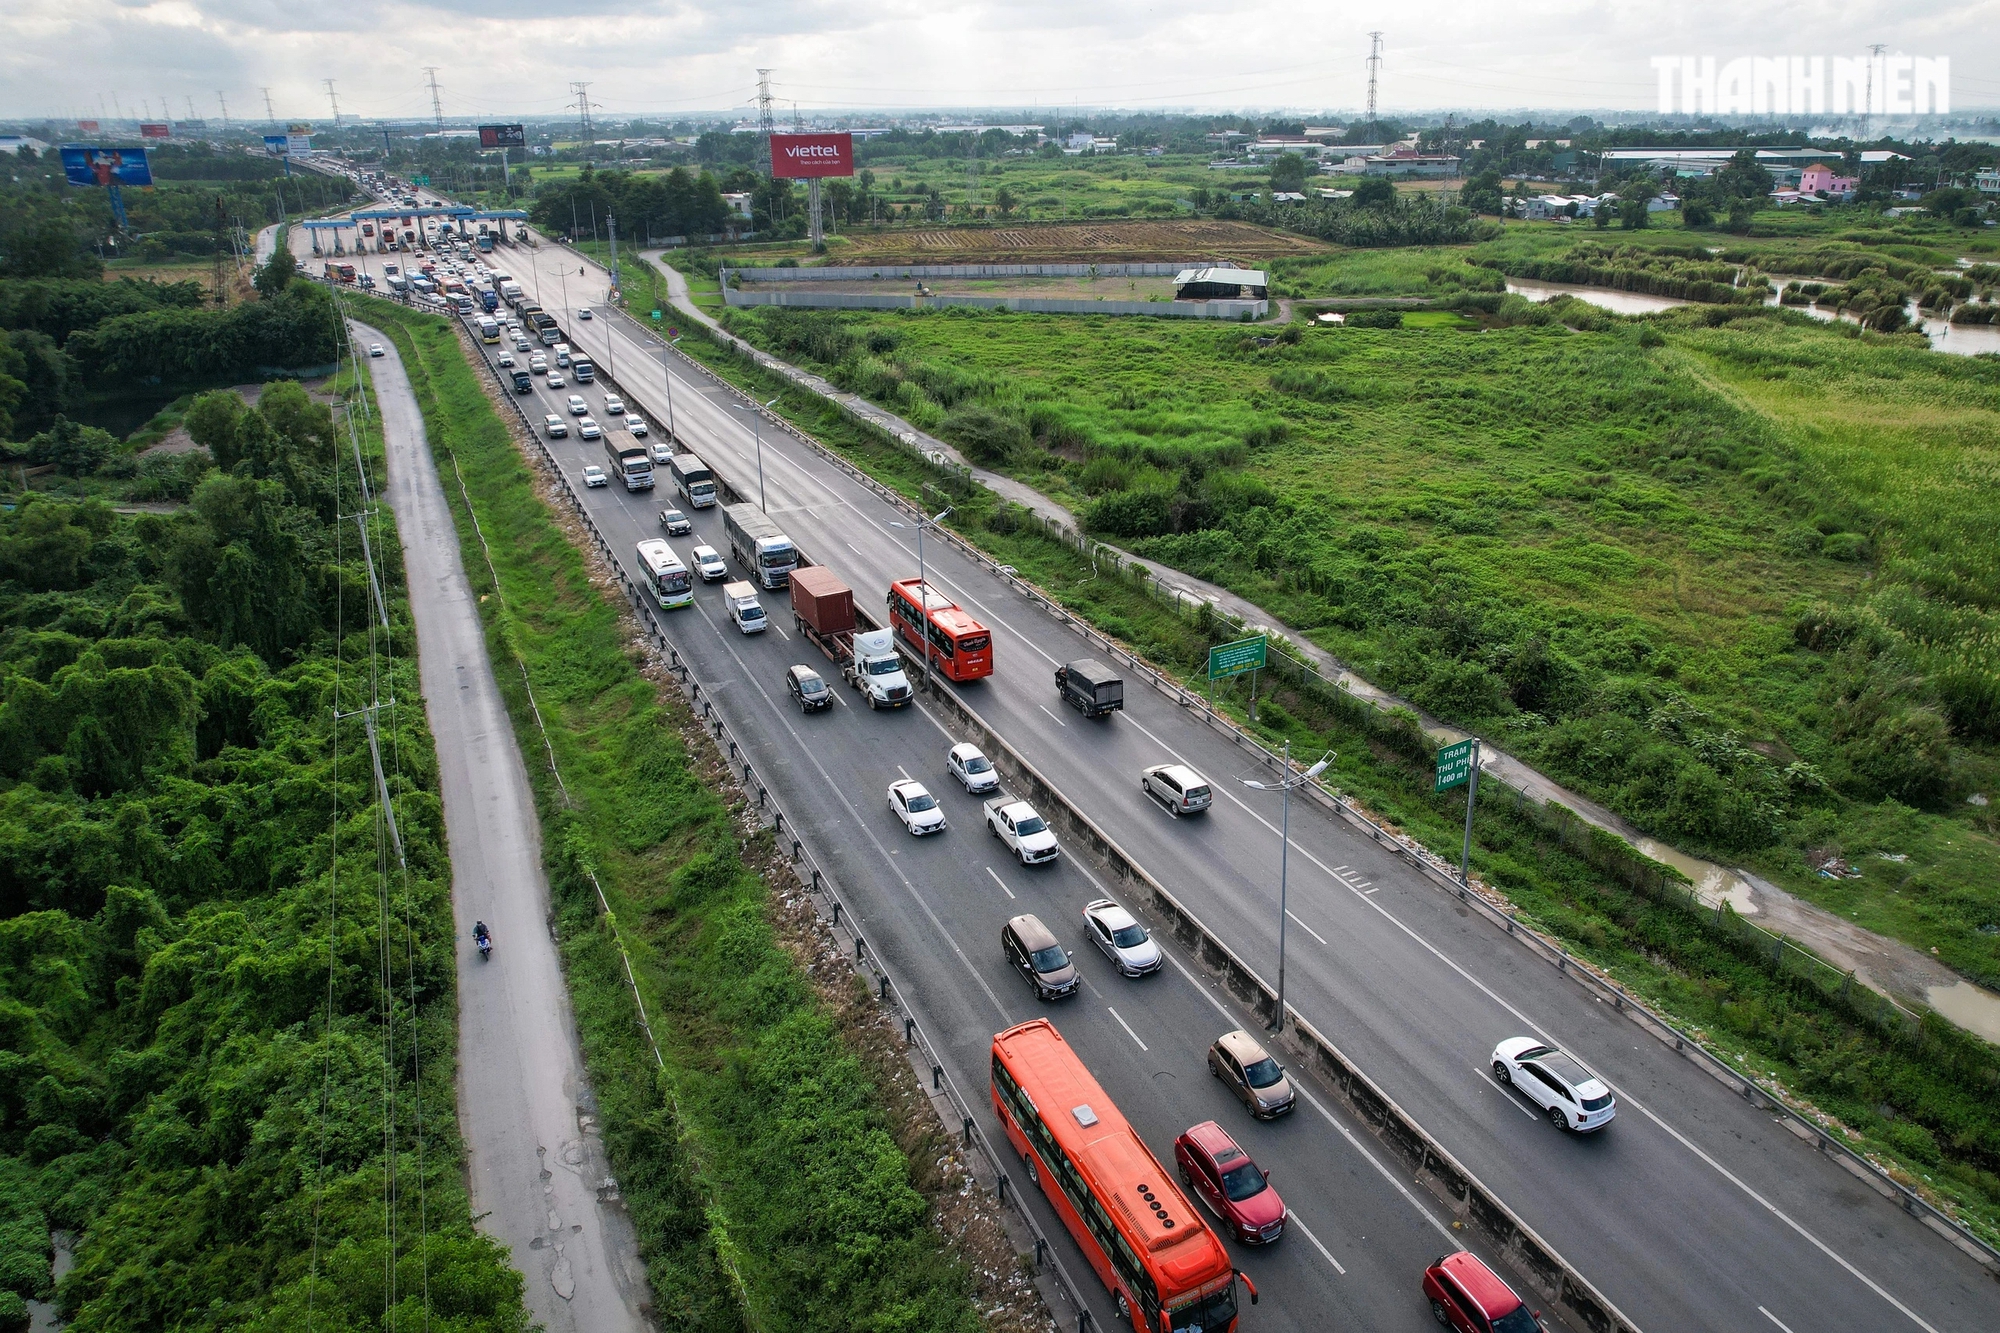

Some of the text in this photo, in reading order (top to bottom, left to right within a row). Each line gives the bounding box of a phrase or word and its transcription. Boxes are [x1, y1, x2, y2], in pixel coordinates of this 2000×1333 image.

[785, 145, 840, 157] viettel
[1444, 746, 1467, 760] TRẠM
[1438, 762, 1453, 774] THU
[1442, 773, 1455, 784] 400
